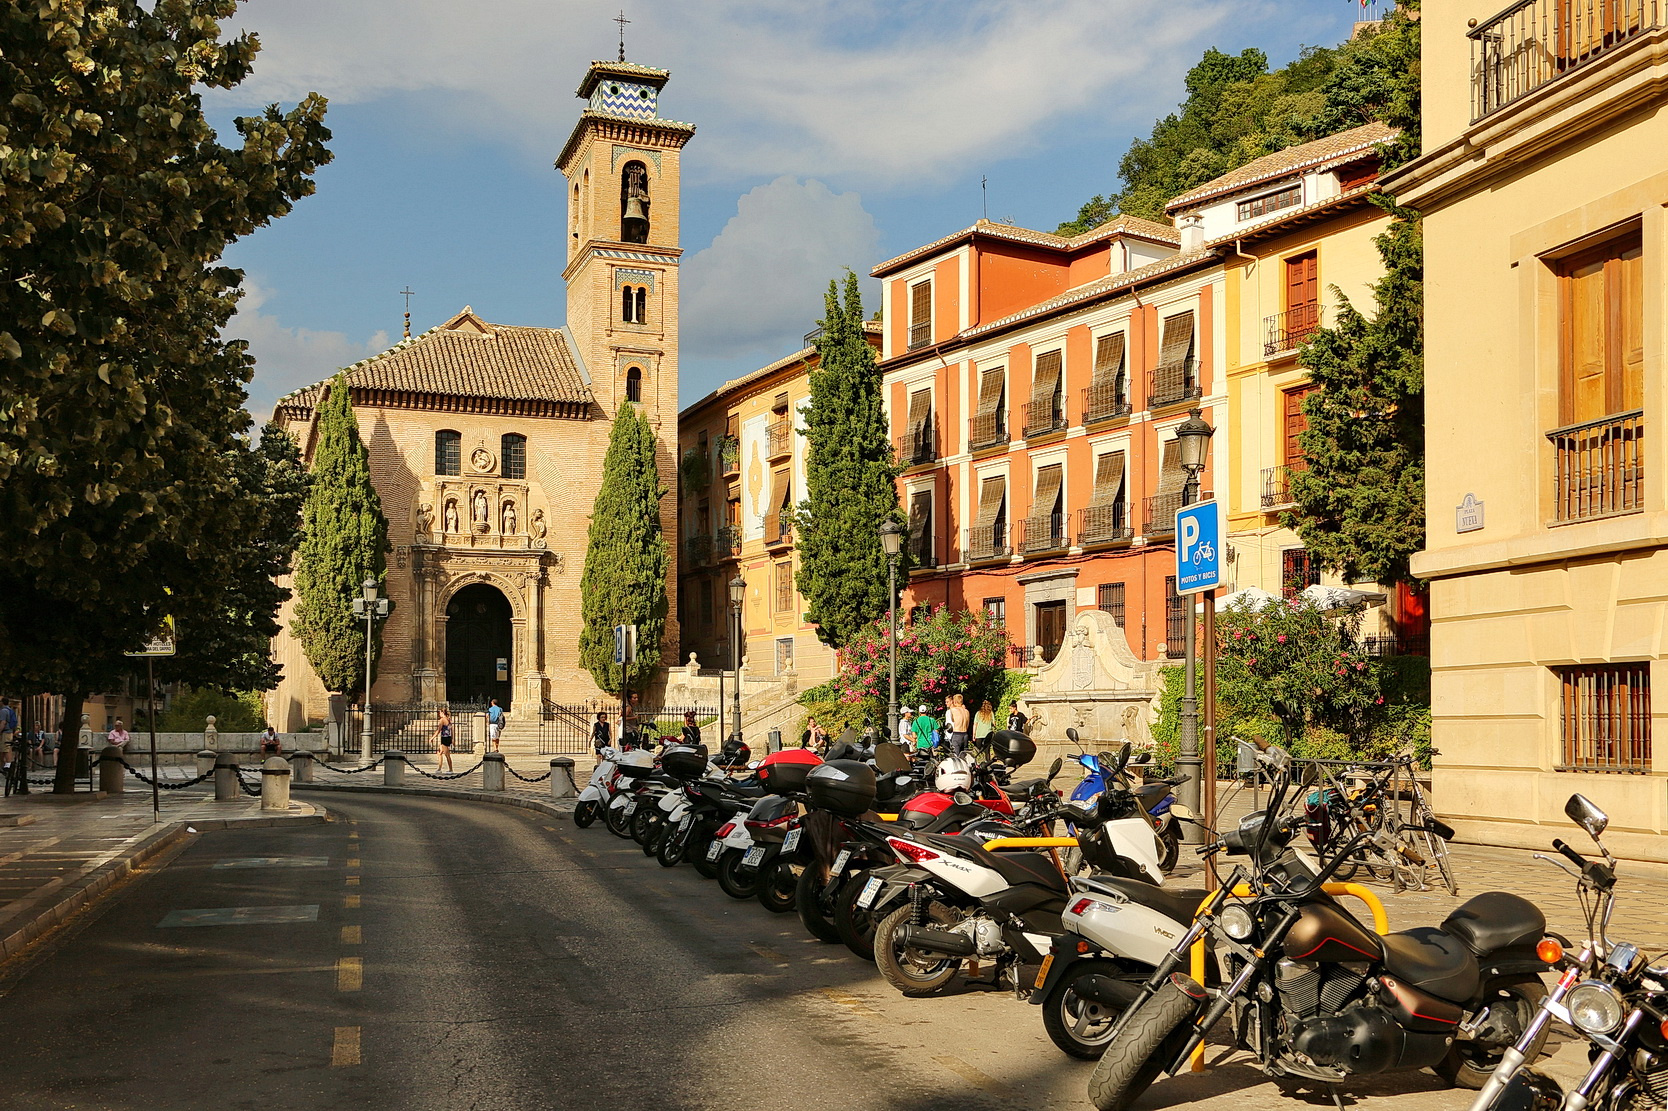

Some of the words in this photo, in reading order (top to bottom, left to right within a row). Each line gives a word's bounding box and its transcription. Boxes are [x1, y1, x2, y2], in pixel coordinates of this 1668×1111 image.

[1181, 516, 1199, 562] P
[1181, 575, 1197, 584] MOTOS
[1203, 570, 1216, 579] BICIS
[81, 734, 89, 746] 2
[208, 734, 216, 745] 3
